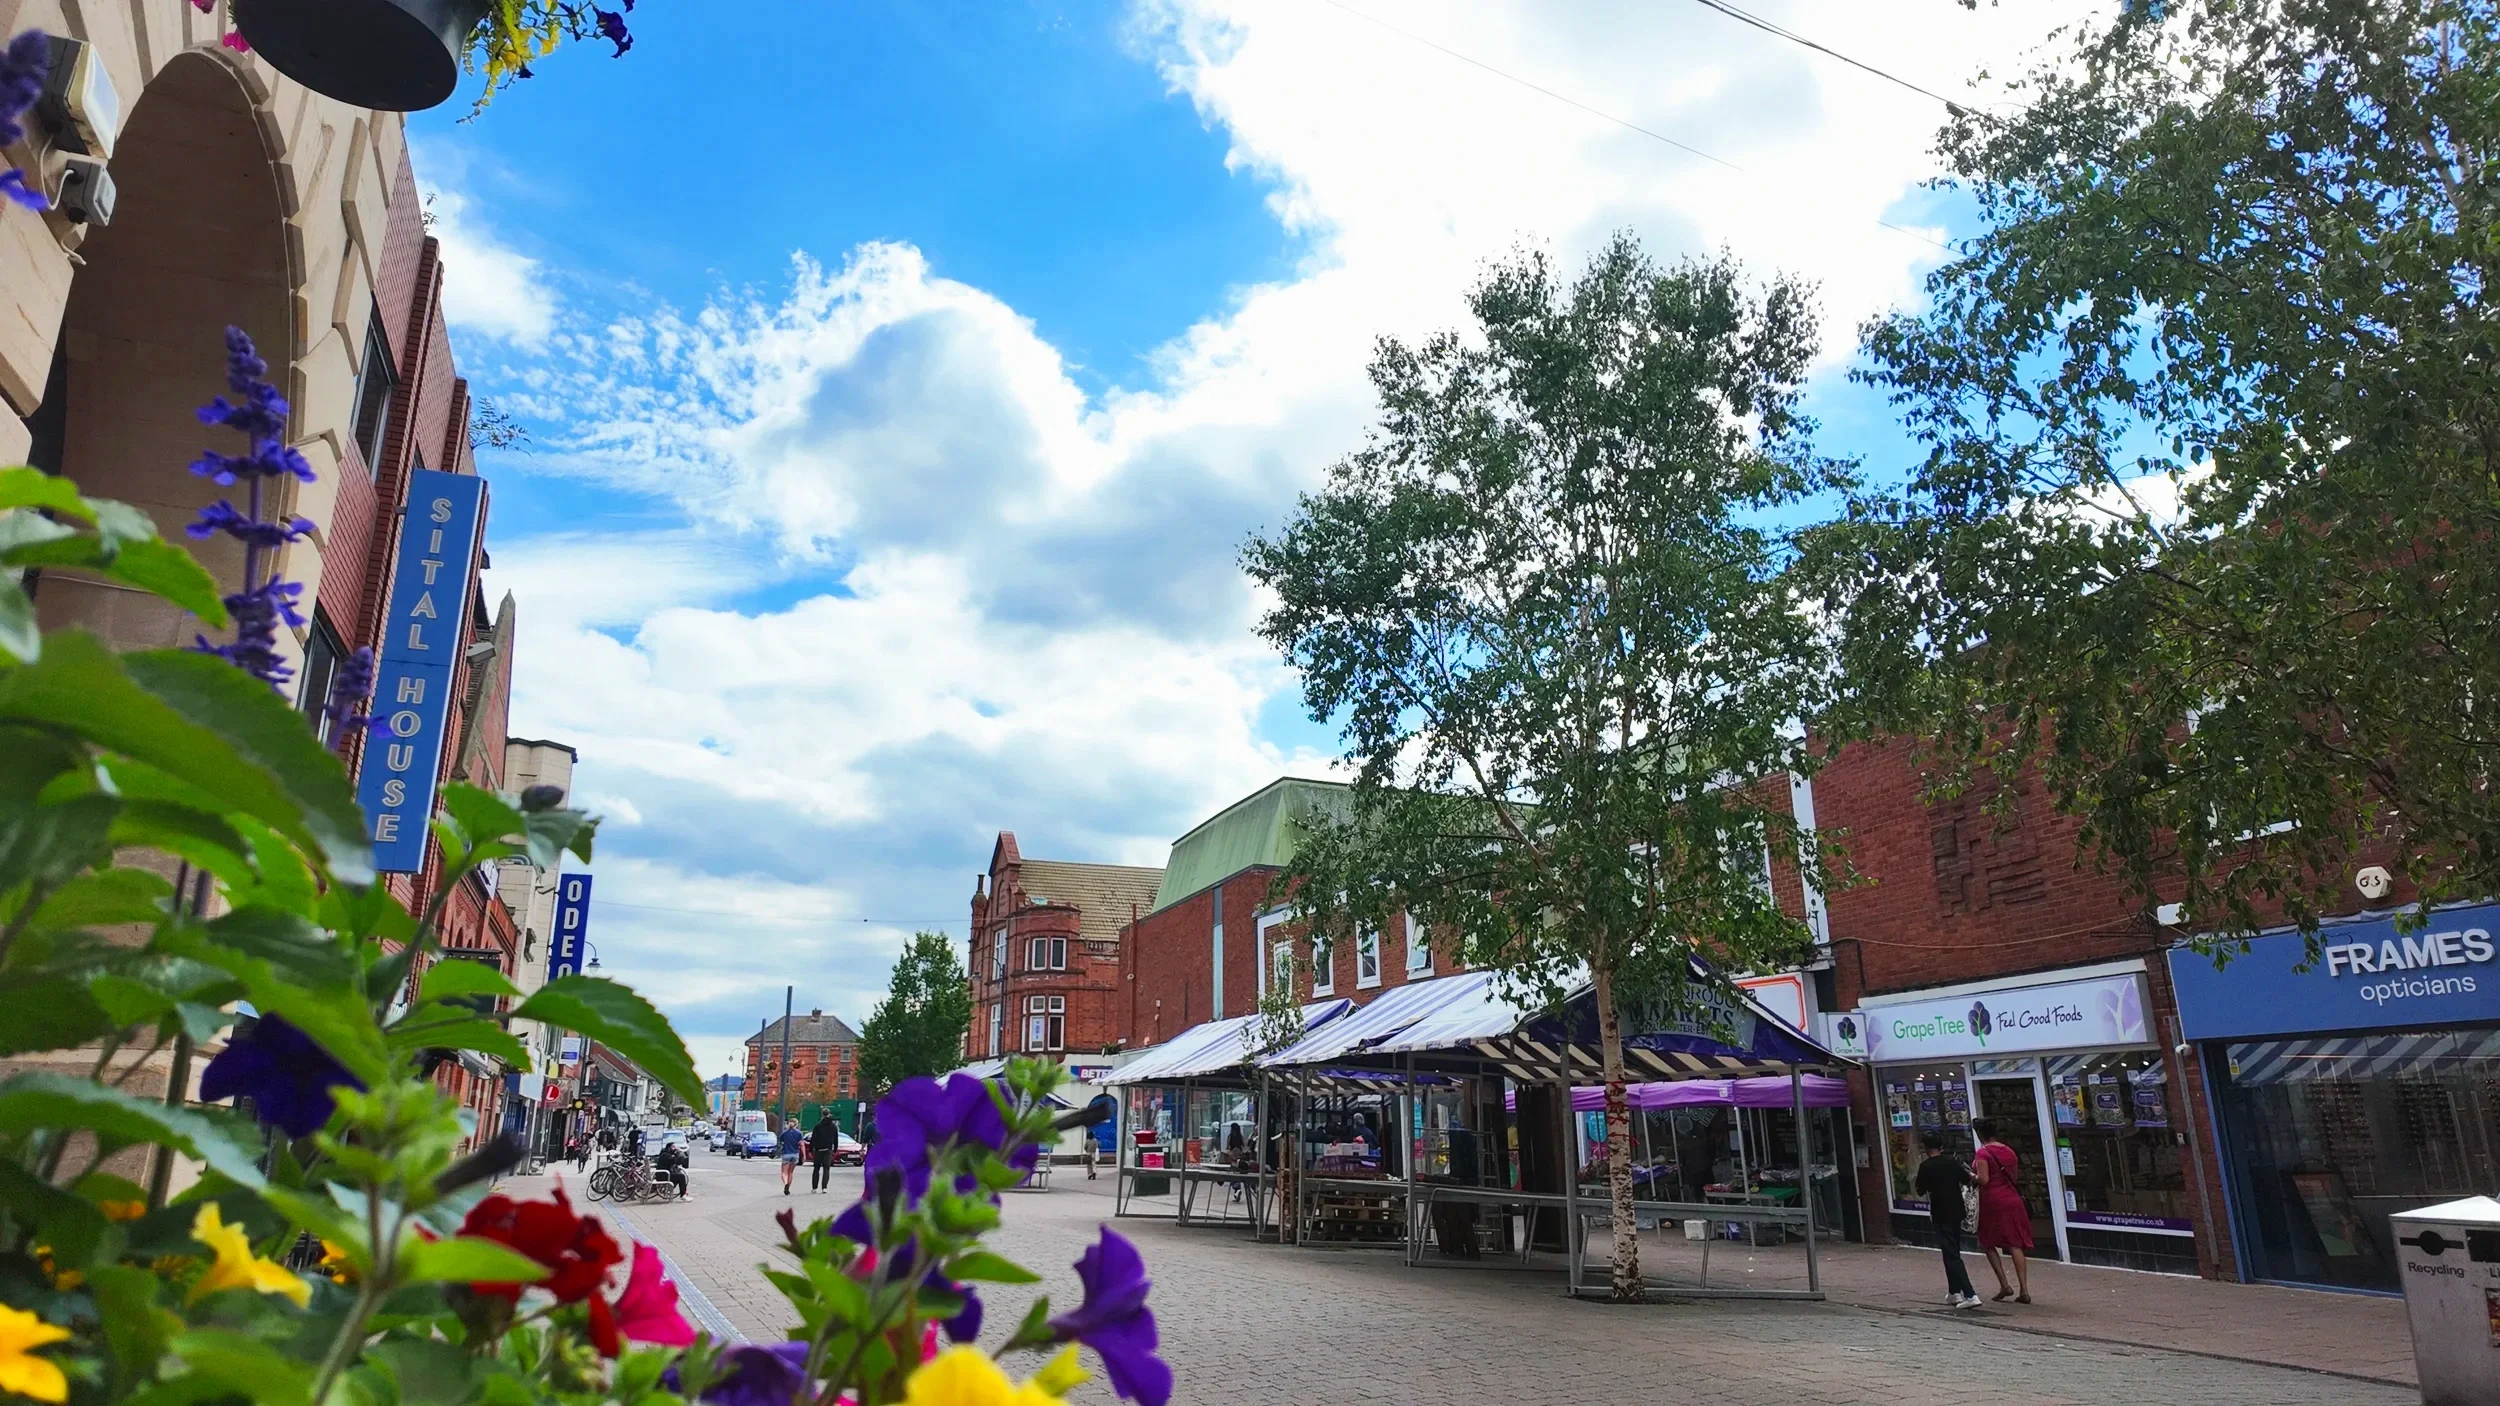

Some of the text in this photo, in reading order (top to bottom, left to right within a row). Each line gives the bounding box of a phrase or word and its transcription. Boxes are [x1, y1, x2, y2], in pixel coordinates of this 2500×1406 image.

[408, 497, 452, 651] SITAL
[375, 676, 426, 843] HOUSE
[557, 879, 583, 980] ODEO
[2325, 928, 2496, 977] FRAMES
[2360, 975, 2477, 1007] opticians
[1893, 1015, 1965, 1042] Grape Tree
[1996, 1004, 2083, 1032] Feel Good Foods
[1835, 1047, 1853, 1055] Grape
[2096, 1214, 2165, 1226] www.grapetree.co.uk
[2407, 1261, 2465, 1279] Recycling
